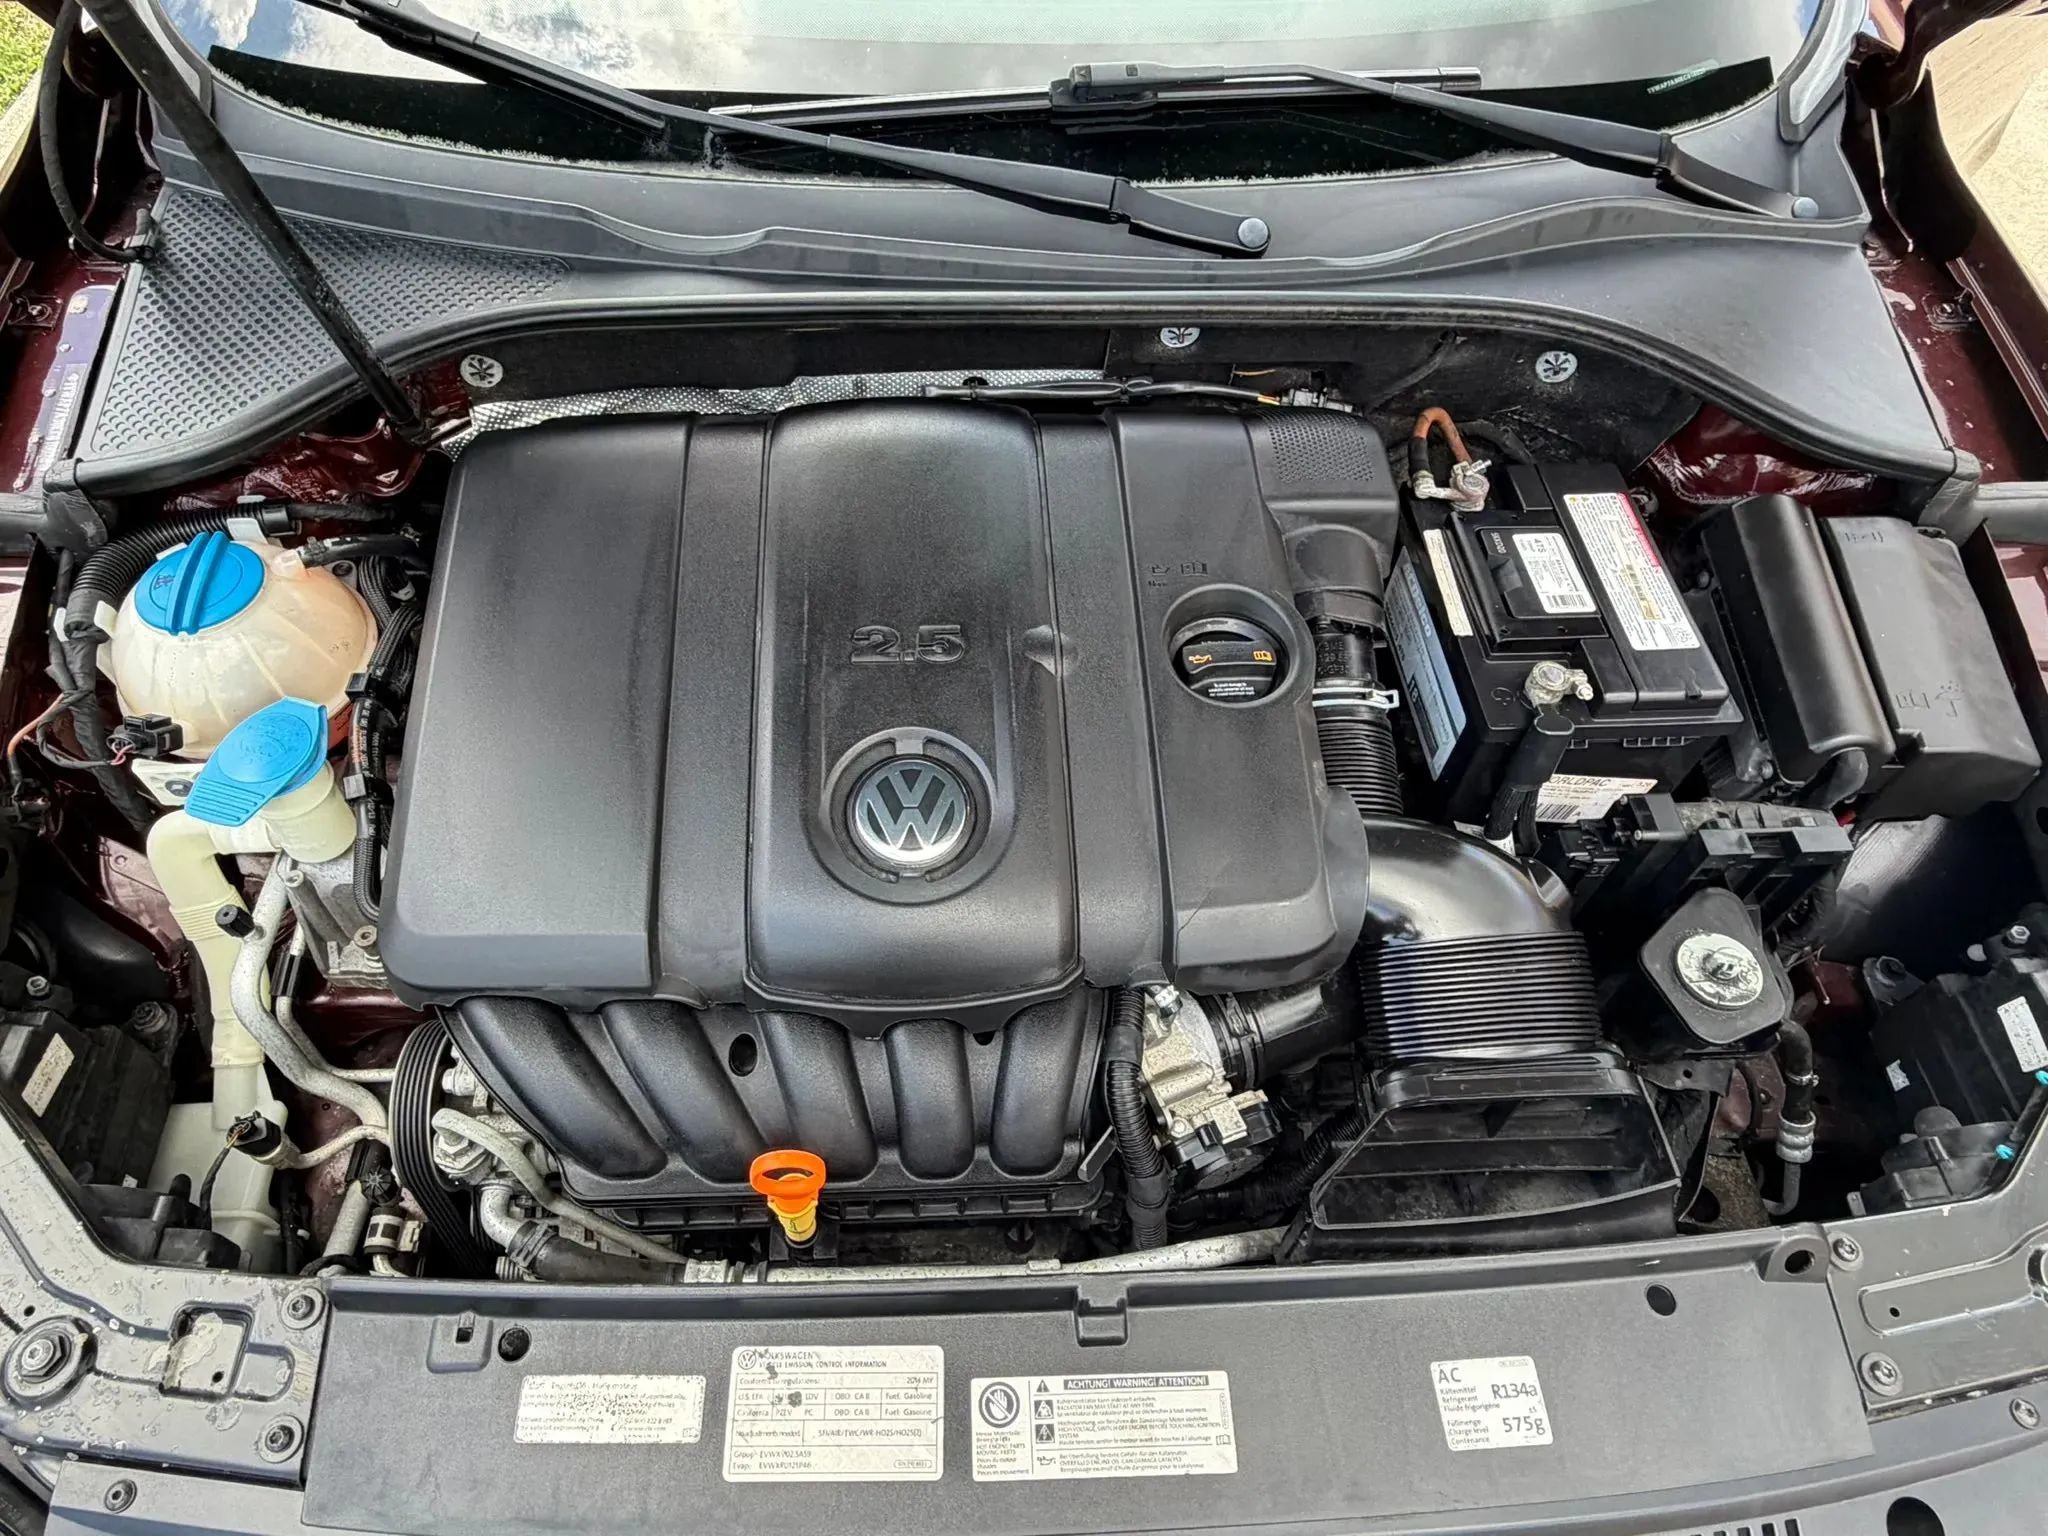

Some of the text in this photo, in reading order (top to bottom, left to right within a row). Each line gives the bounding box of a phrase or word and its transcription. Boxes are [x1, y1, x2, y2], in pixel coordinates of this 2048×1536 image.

[851, 624, 966, 664] 2.5
[1549, 776, 1608, 787] ORLDPAC
[1067, 1376, 1206, 1390] ACHTUNG! WARNING! ATTENTION!
[1439, 1367, 1462, 1384] AC
[1491, 1383, 1538, 1400] R134a
[1502, 1416, 1546, 1436] 575g
